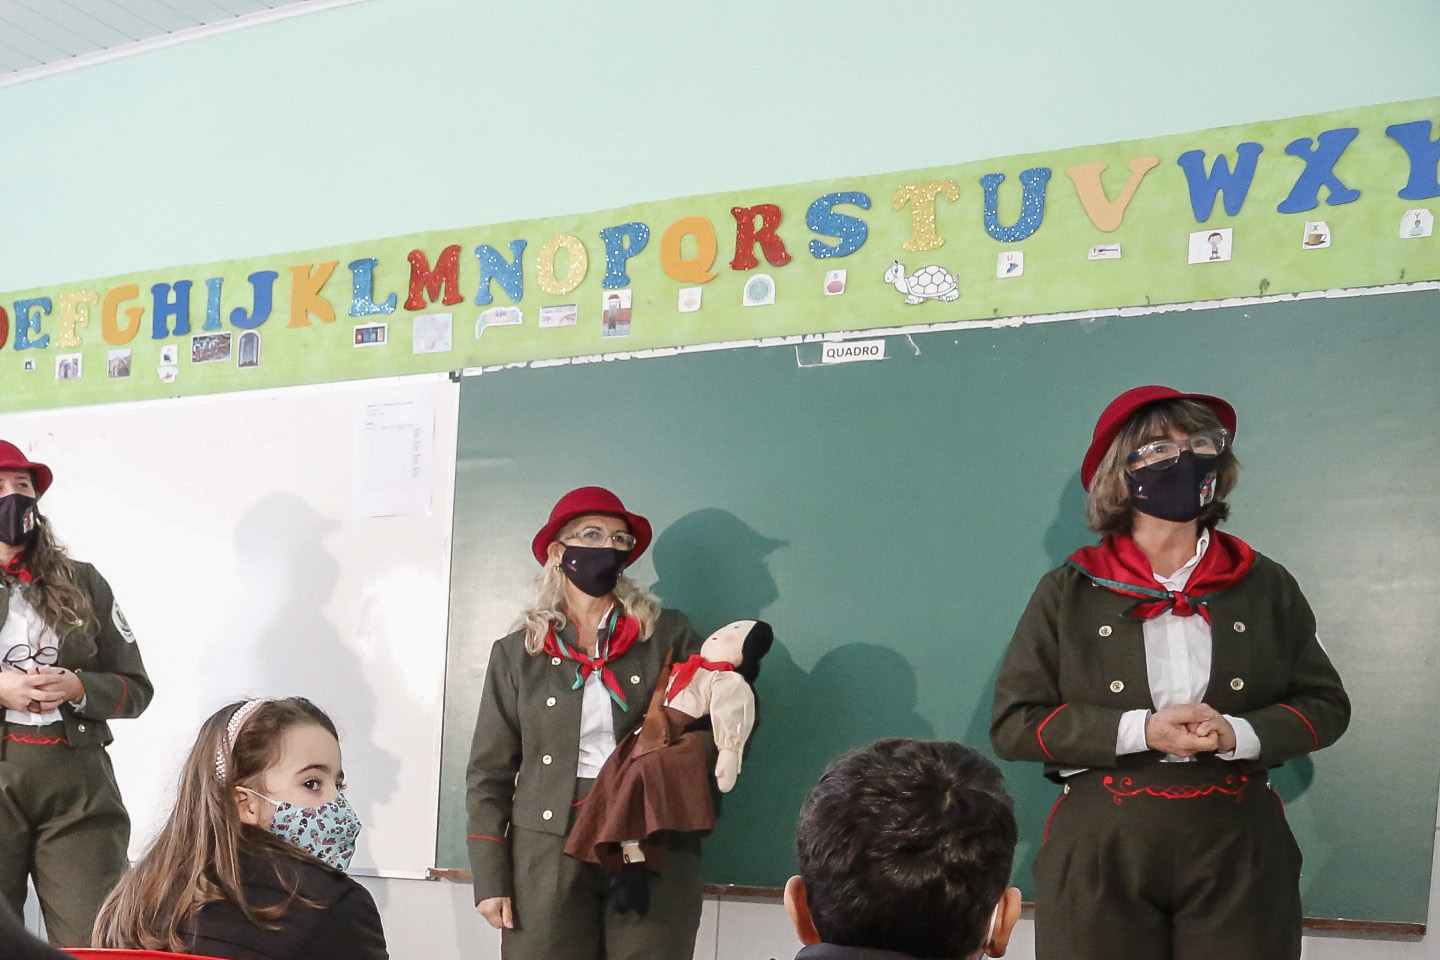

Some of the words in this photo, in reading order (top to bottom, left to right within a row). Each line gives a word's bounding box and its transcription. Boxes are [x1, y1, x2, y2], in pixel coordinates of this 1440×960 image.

[14, 297, 52, 351] E
[56, 290, 98, 348] F
[101, 284, 144, 345] G
[151, 280, 193, 339] H
[203, 278, 225, 330] I
[230, 271, 278, 328] J
[286, 261, 339, 328] K
[348, 257, 397, 317] L
[404, 244, 464, 311] M
[475, 239, 527, 306] N
[537, 234, 588, 296] O
[600, 222, 650, 288] P
[660, 216, 718, 284] Q
[728, 203, 792, 271] R
[806, 191, 871, 259] S
[892, 179, 960, 252] T
[980, 167, 1051, 242] U
[1066, 157, 1160, 232] V
[1178, 142, 1263, 222] W
[1277, 128, 1360, 213] X
[1386, 120, 1440, 199] Y
[826, 346, 880, 358] QUADRO
